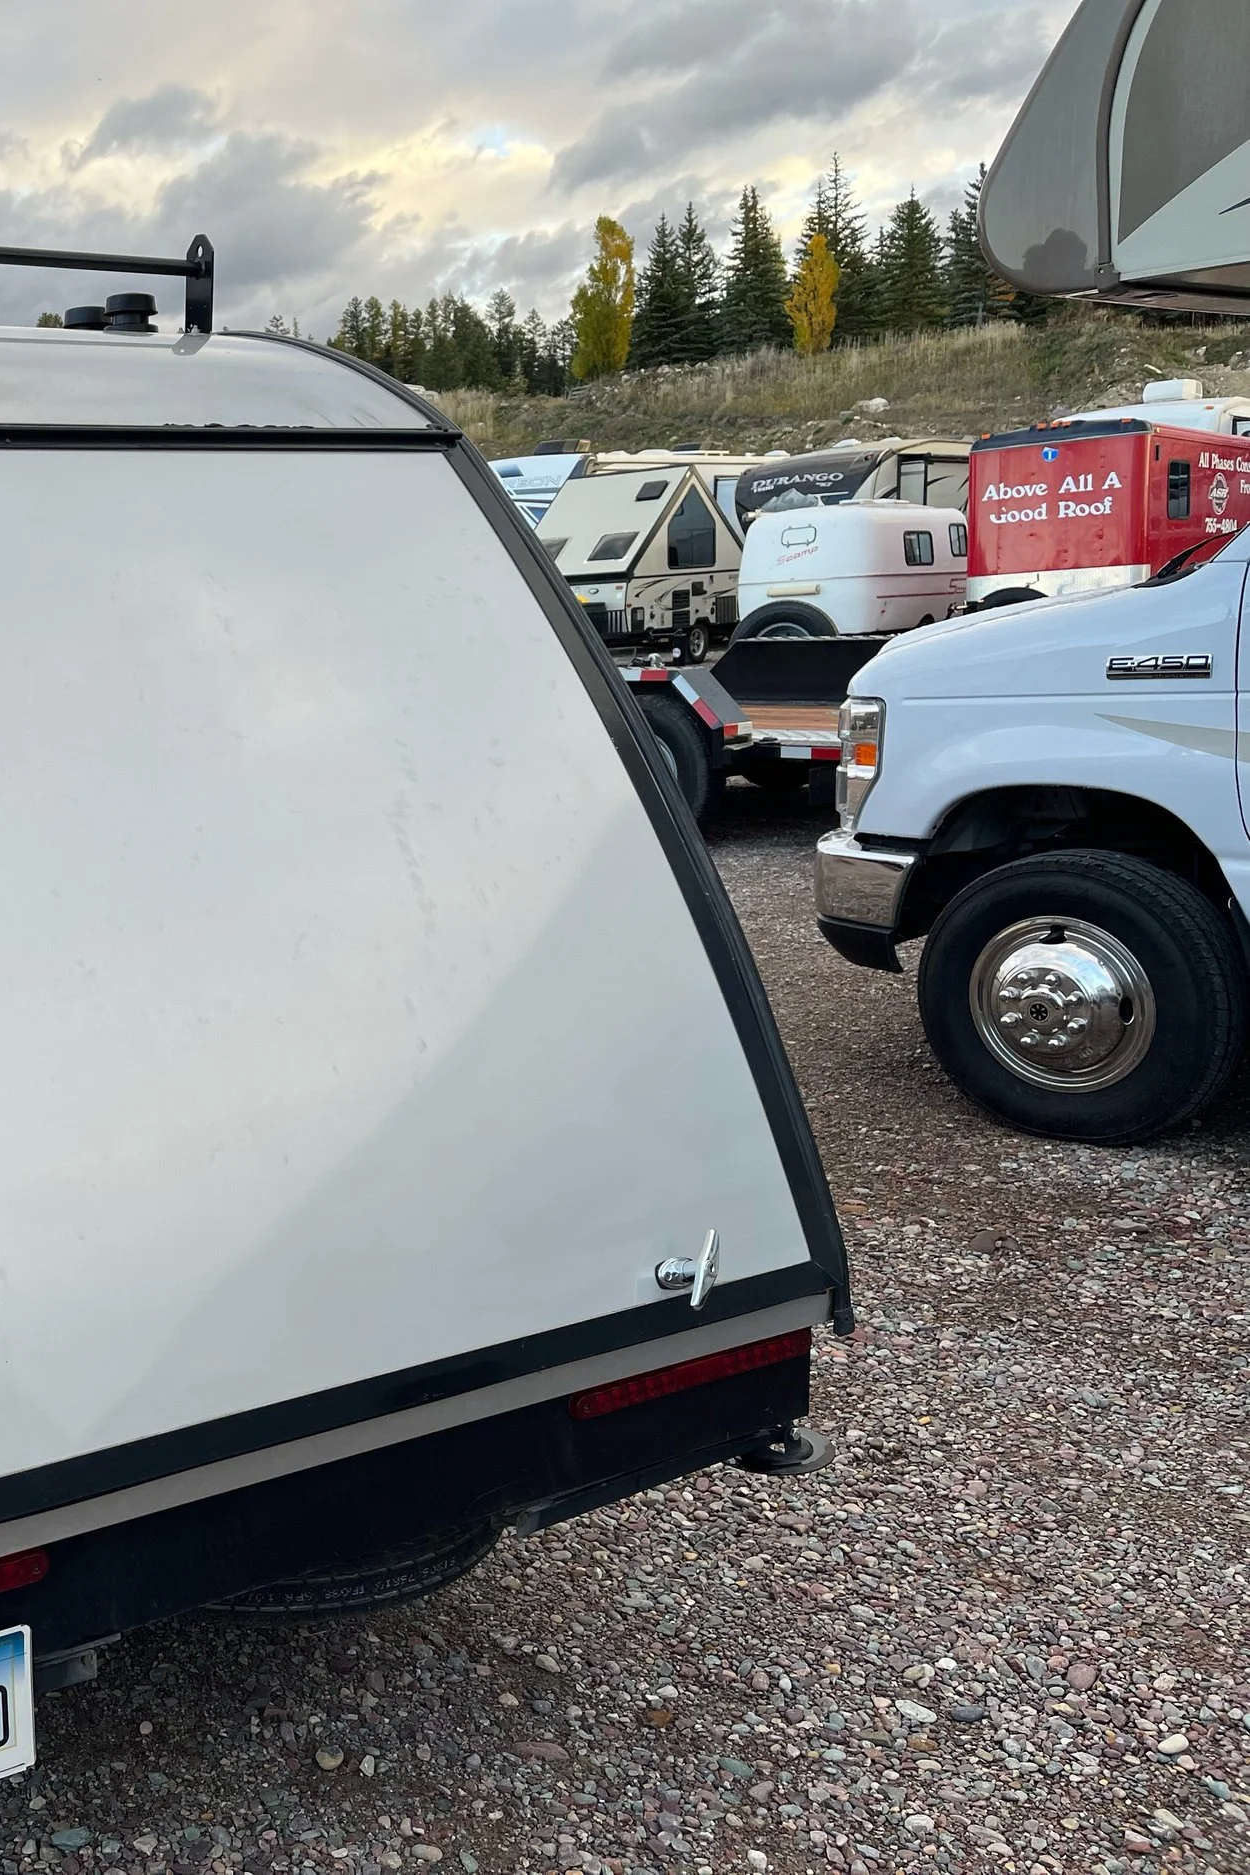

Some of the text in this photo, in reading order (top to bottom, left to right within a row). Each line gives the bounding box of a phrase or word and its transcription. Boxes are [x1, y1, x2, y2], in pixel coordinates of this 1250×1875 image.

[1198, 451, 1210, 468] All
[1211, 453, 1234, 471] Phases
[750, 472, 844, 490] DURANGO
[981, 471, 1123, 501] Above All A
[1057, 496, 1113, 519] Roof
[776, 545, 818, 566] Scamp
